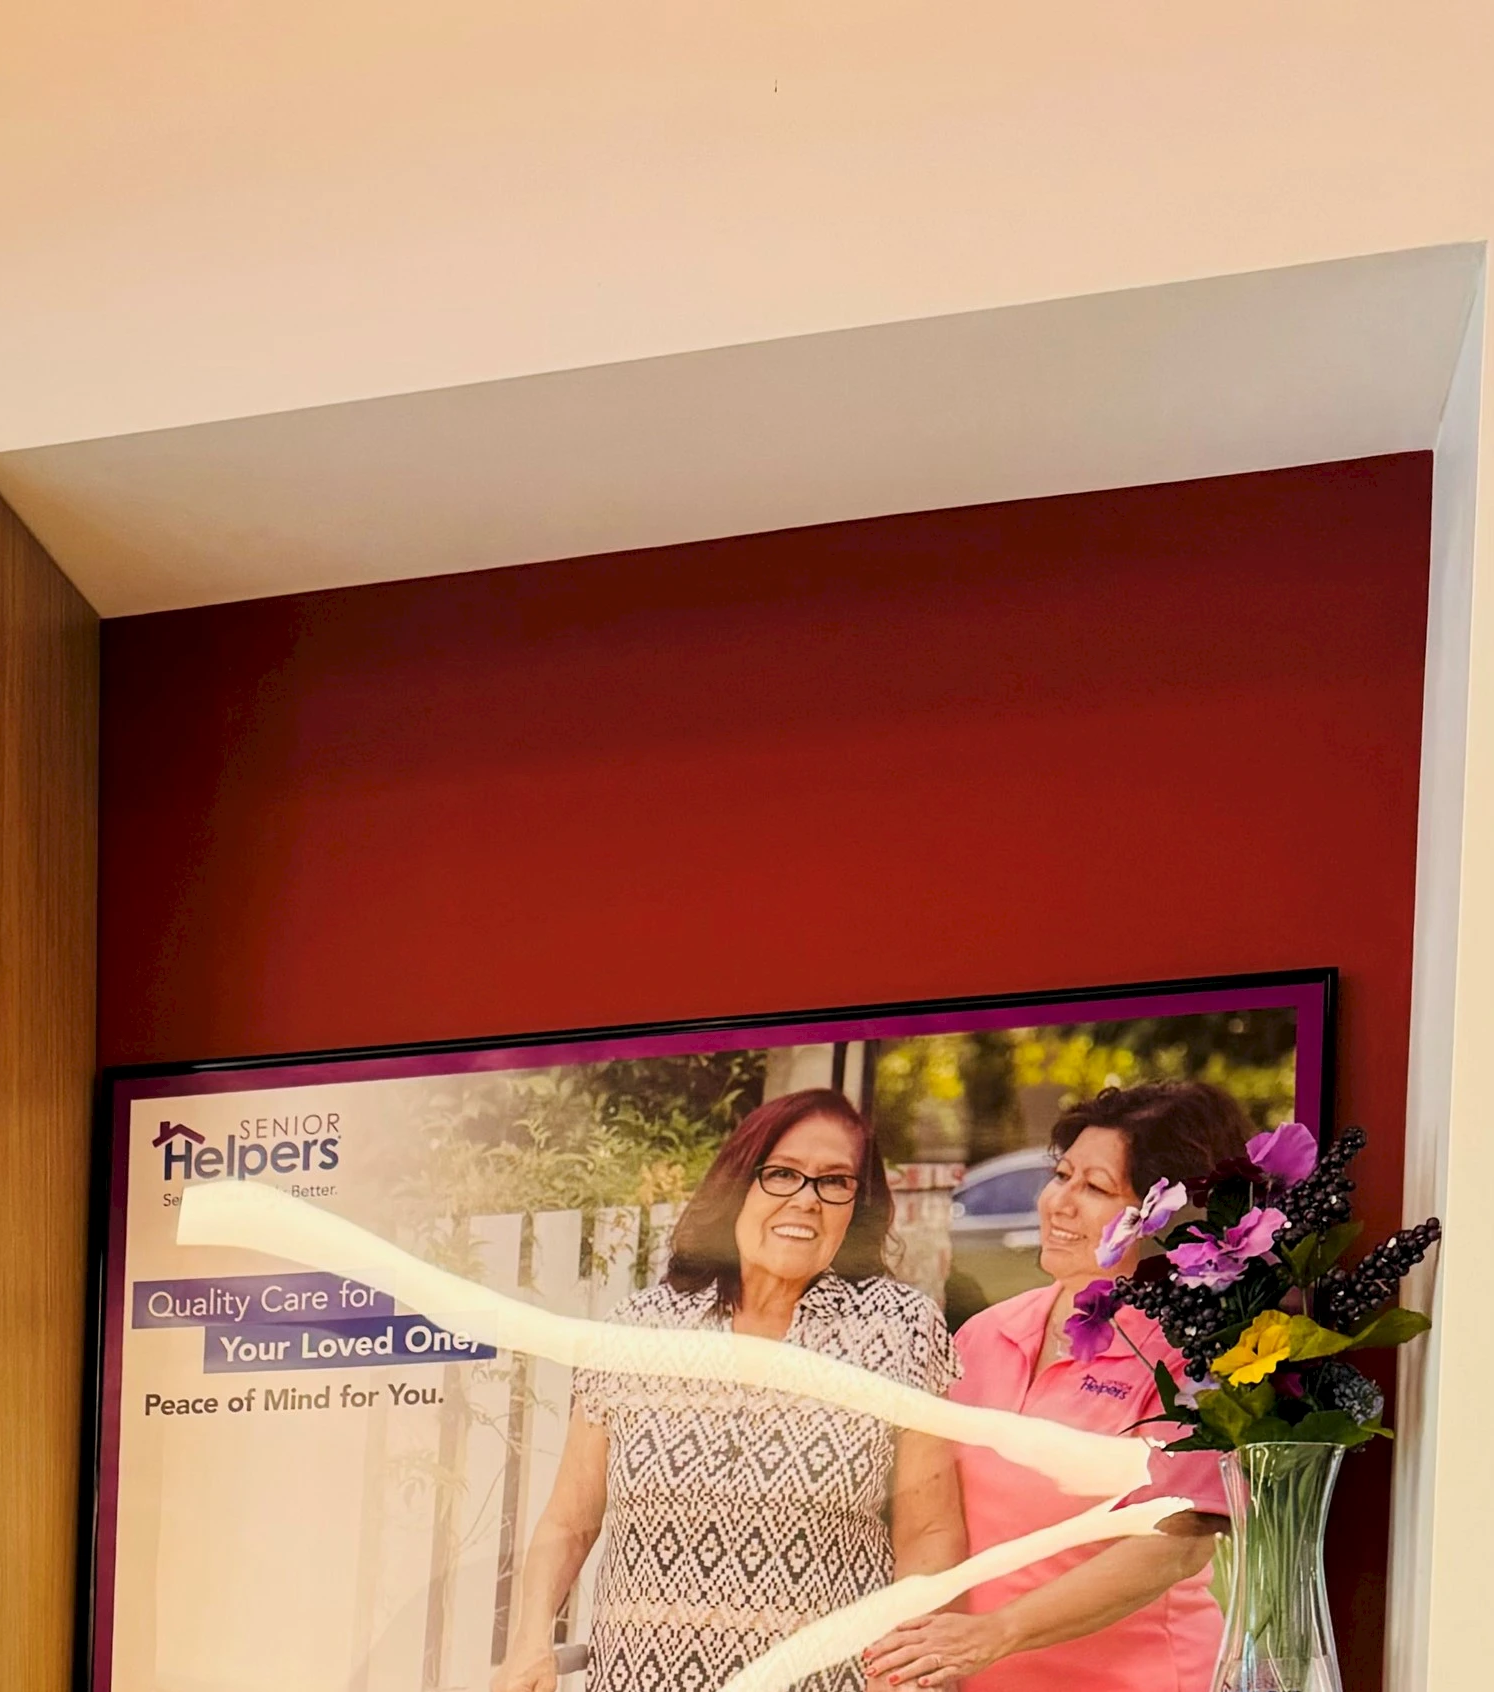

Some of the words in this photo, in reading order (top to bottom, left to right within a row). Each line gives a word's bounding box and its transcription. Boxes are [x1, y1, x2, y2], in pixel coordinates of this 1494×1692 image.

[239, 1113, 340, 1140] SENIOR
[164, 1135, 340, 1181] Helpers
[291, 1184, 338, 1198] Better.
[148, 1288, 251, 1322] Quality
[261, 1286, 328, 1314] Care
[339, 1281, 379, 1308] for
[219, 1336, 290, 1363] Your
[301, 1327, 393, 1359] Loved
[405, 1325, 480, 1354] One,
[144, 1393, 218, 1416] Peace
[228, 1389, 256, 1412] of
[264, 1385, 331, 1411] Mind
[340, 1384, 379, 1408] for
[388, 1383, 444, 1406] You.
